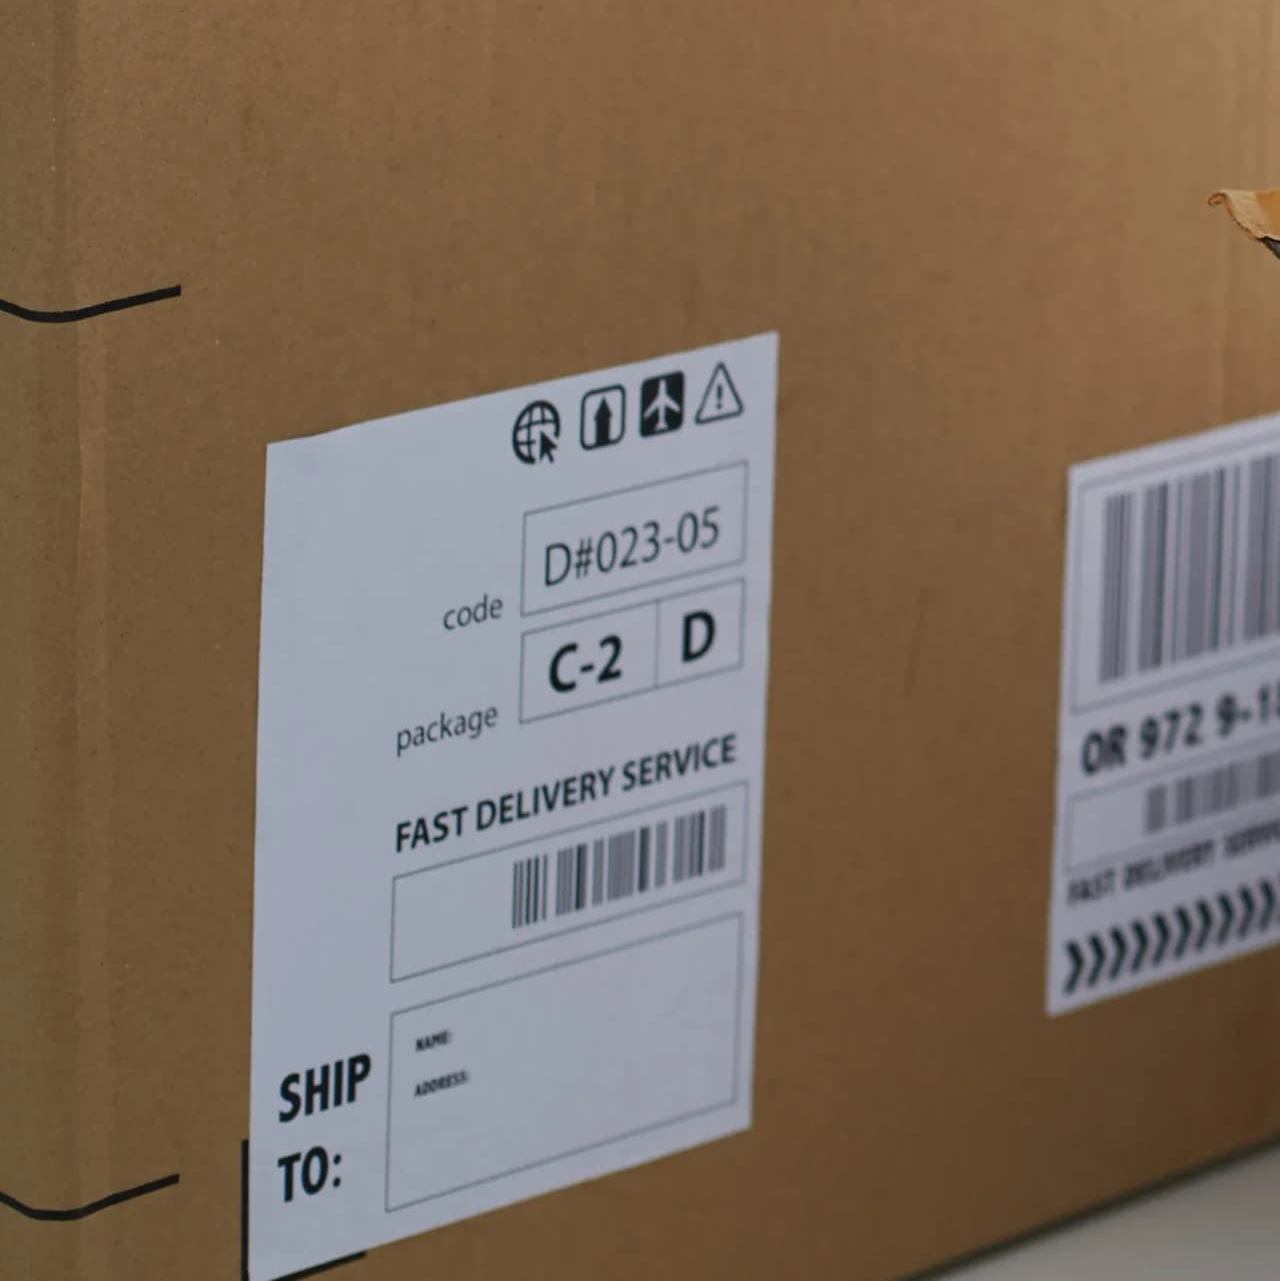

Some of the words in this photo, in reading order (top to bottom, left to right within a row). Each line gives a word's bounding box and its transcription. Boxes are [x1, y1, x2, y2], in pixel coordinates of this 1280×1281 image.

[544, 505, 720, 588] D#023-05
[442, 593, 504, 631] code
[548, 634, 622, 693] C-2
[681, 610, 716, 663] D
[396, 706, 499, 759] package
[1081, 724, 1128, 776] OR
[1139, 703, 1204, 760] 972
[395, 805, 469, 853] FAST
[476, 766, 615, 832] DELIVERY
[622, 733, 736, 792] SERVICE
[278, 1053, 372, 1123] SHIP
[277, 1145, 342, 1203] TO:
